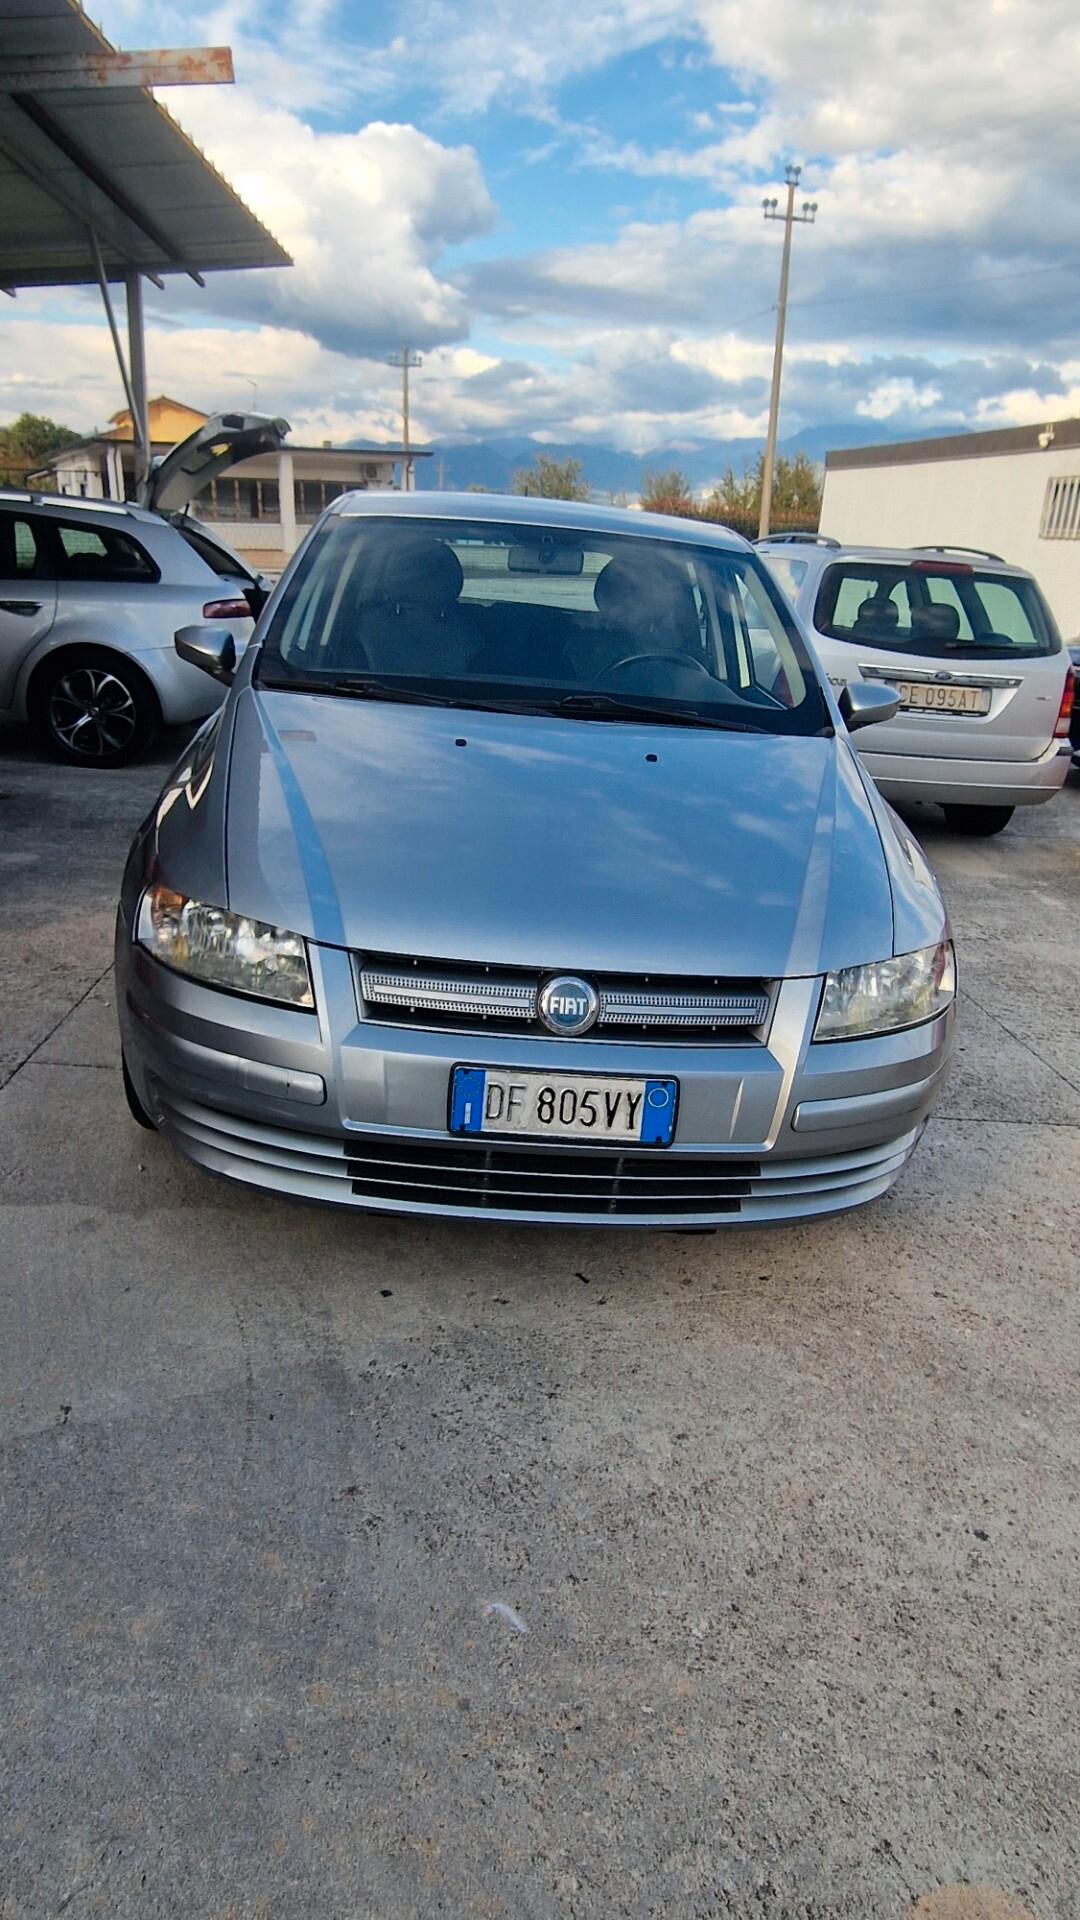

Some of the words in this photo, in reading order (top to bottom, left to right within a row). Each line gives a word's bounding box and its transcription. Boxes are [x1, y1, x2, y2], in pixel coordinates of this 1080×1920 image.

[899, 684, 919, 704] CE
[926, 687, 980, 709] 095AT
[550, 996, 588, 1015] FIAT
[485, 1082, 527, 1122] DF
[537, 1086, 642, 1130] 805VY
